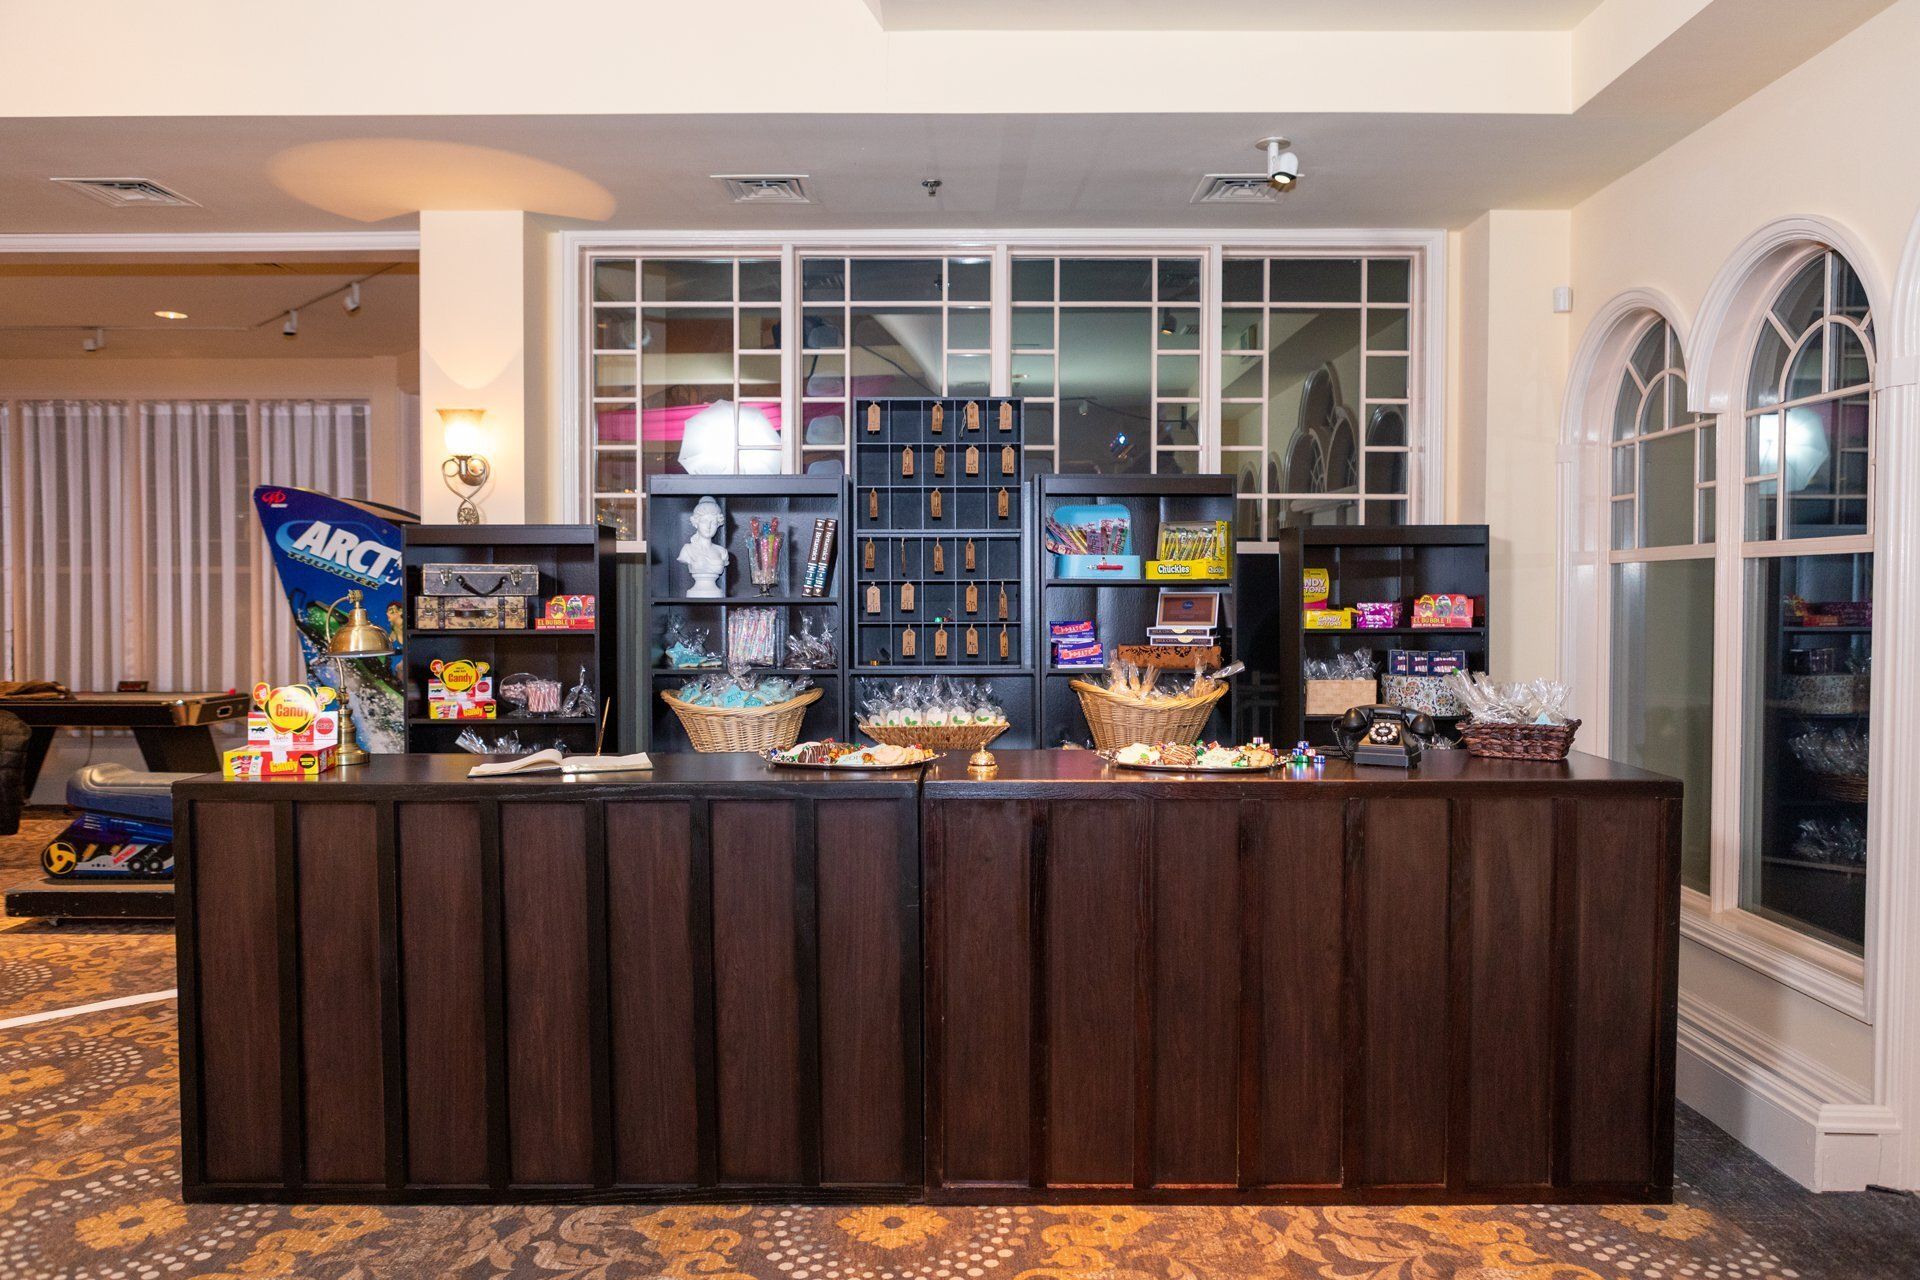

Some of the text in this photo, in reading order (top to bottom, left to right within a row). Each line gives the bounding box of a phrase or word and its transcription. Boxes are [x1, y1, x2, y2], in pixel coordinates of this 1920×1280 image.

[288, 551, 380, 590] THUNDER
[1157, 564, 1190, 575] Chuckles
[1304, 578, 1326, 588] NDY
[448, 673, 473, 682] Candy
[276, 704, 310, 719] Candy
[269, 759, 298, 773] Candy
